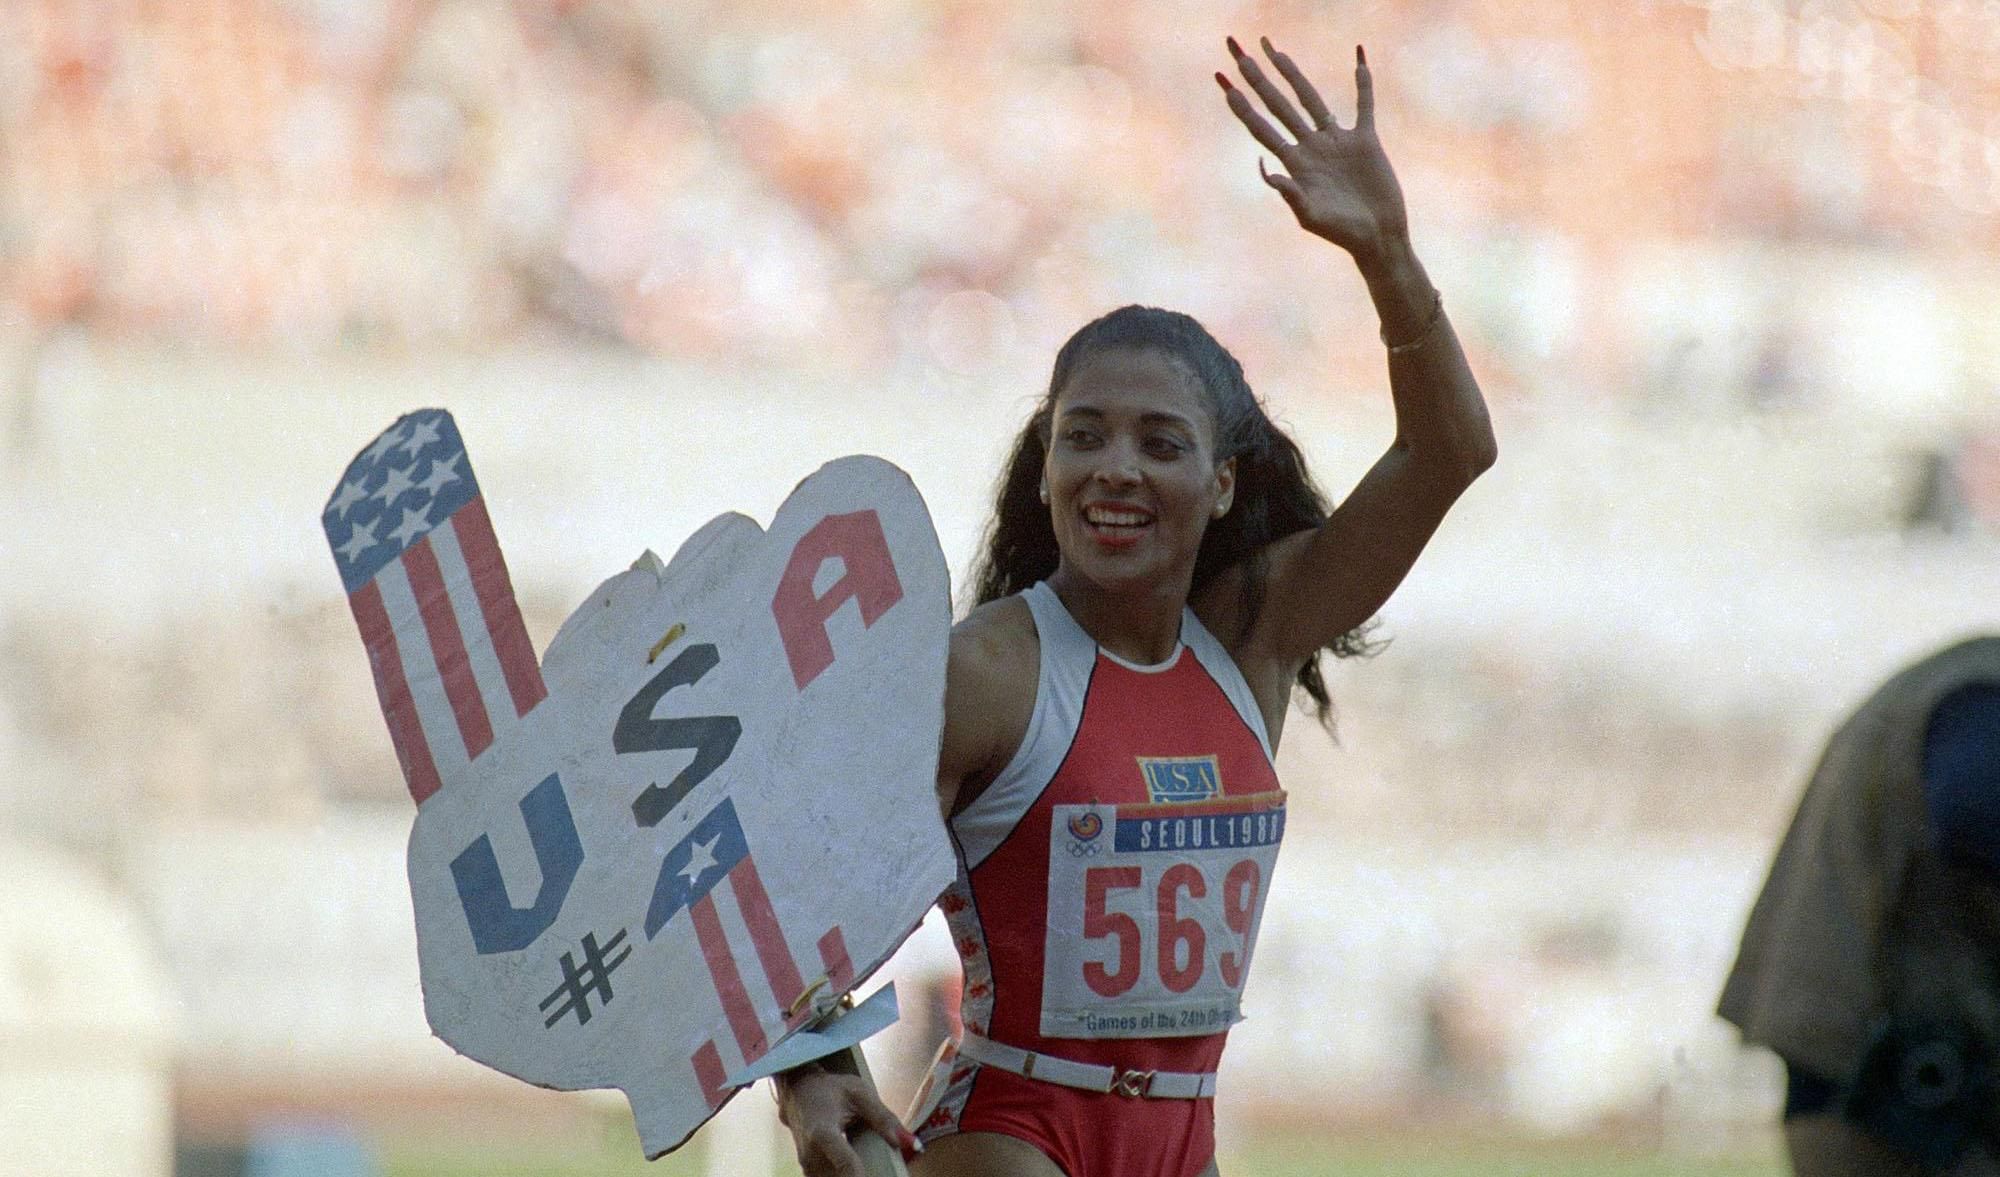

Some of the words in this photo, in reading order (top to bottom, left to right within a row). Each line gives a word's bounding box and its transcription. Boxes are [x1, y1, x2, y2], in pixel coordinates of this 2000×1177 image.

[448, 509, 904, 955] USA
[1146, 762, 1215, 792] USA
[1082, 858, 1261, 998] 569
[1086, 1013, 1137, 1032] Games
[1141, 1014, 1154, 1029] of
